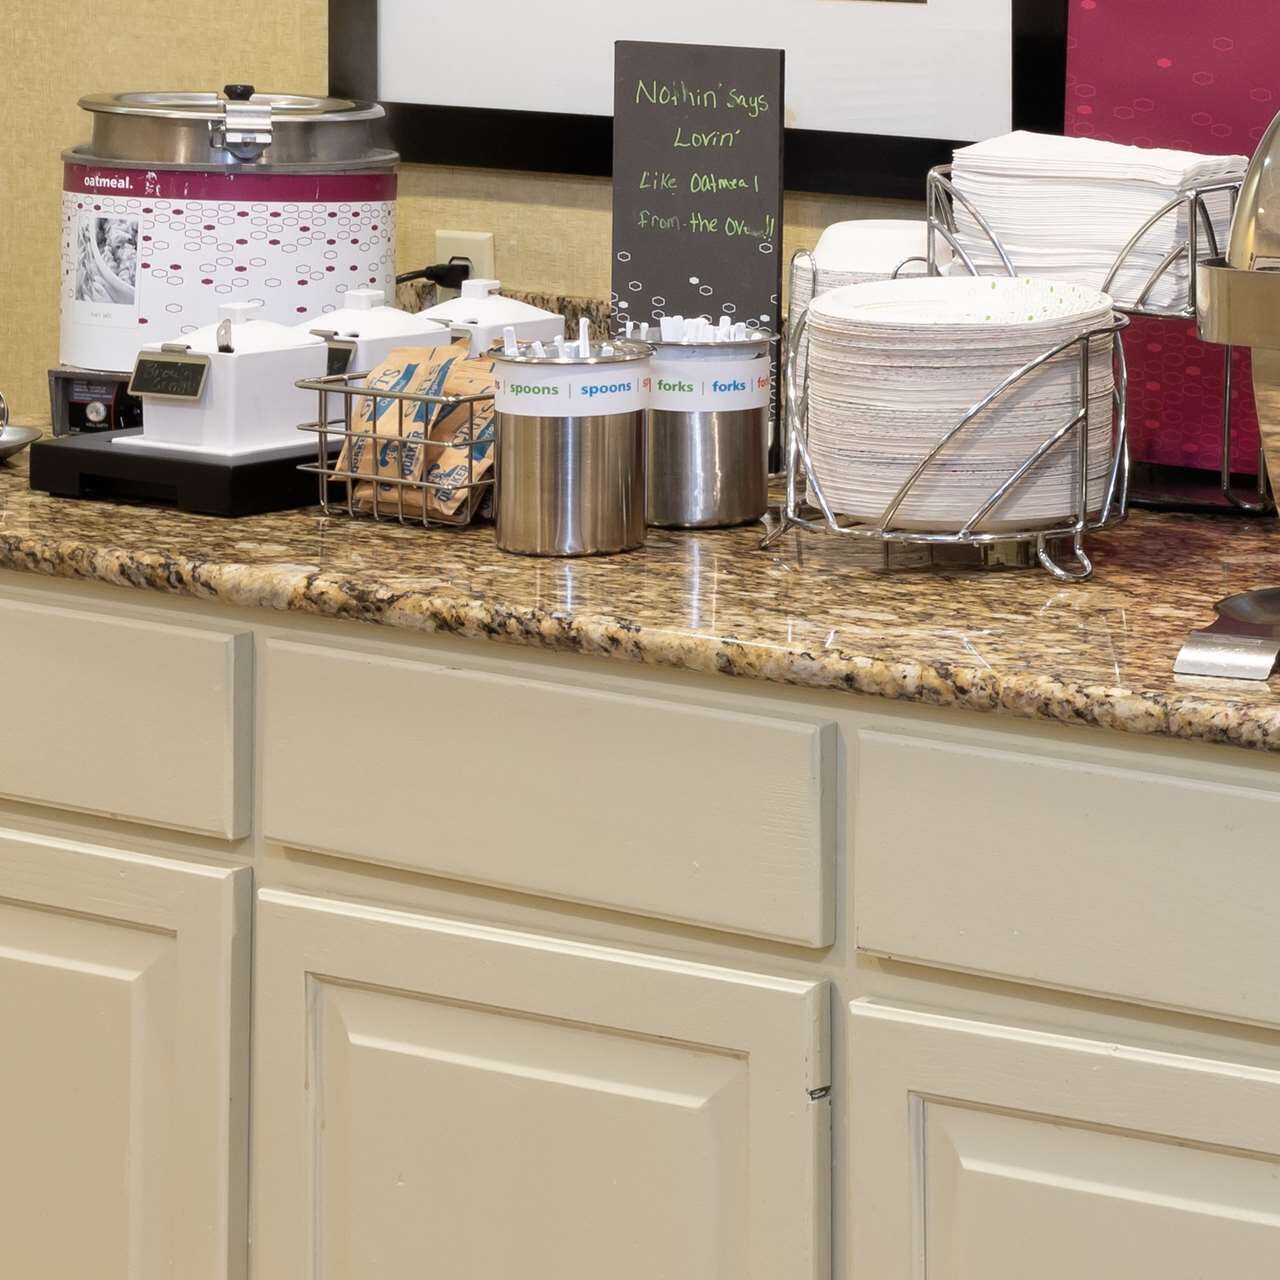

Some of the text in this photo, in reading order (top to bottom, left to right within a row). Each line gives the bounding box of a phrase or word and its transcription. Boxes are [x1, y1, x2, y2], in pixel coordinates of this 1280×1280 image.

[84, 176, 134, 190] oatmeal.
[640, 172, 677, 190] Like
[510, 382, 560, 396] spoons
[581, 380, 632, 397] spoons
[657, 379, 694, 392] forks
[712, 378, 746, 392] forks
